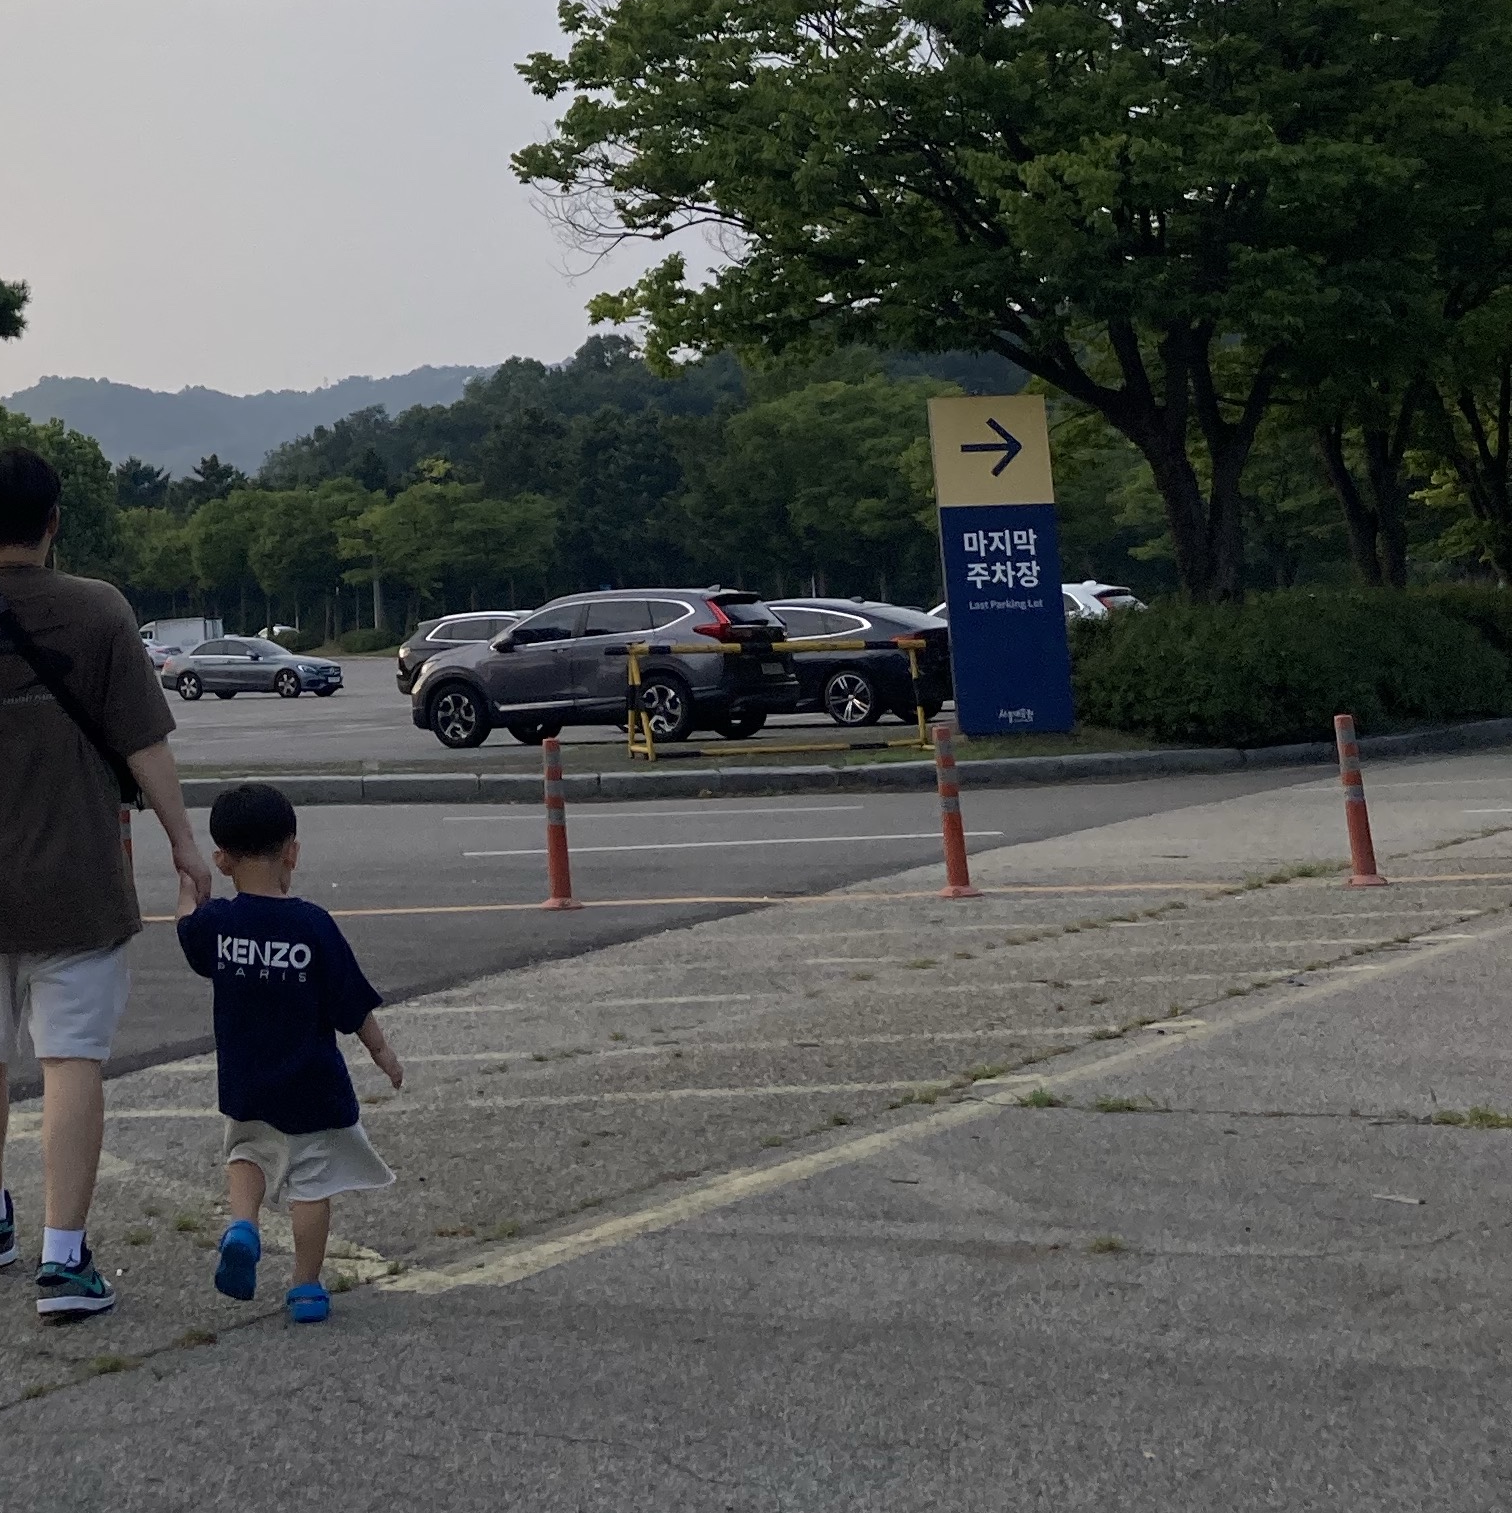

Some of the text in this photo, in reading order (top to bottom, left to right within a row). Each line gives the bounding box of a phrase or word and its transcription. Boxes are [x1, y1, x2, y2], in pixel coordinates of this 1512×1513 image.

[963, 528, 1038, 557] 마지막
[966, 560, 1041, 589] 주차장
[968, 598, 1044, 611] Last Parking Lot
[217, 933, 312, 969] KENZO
[217, 961, 307, 982] PARIS
